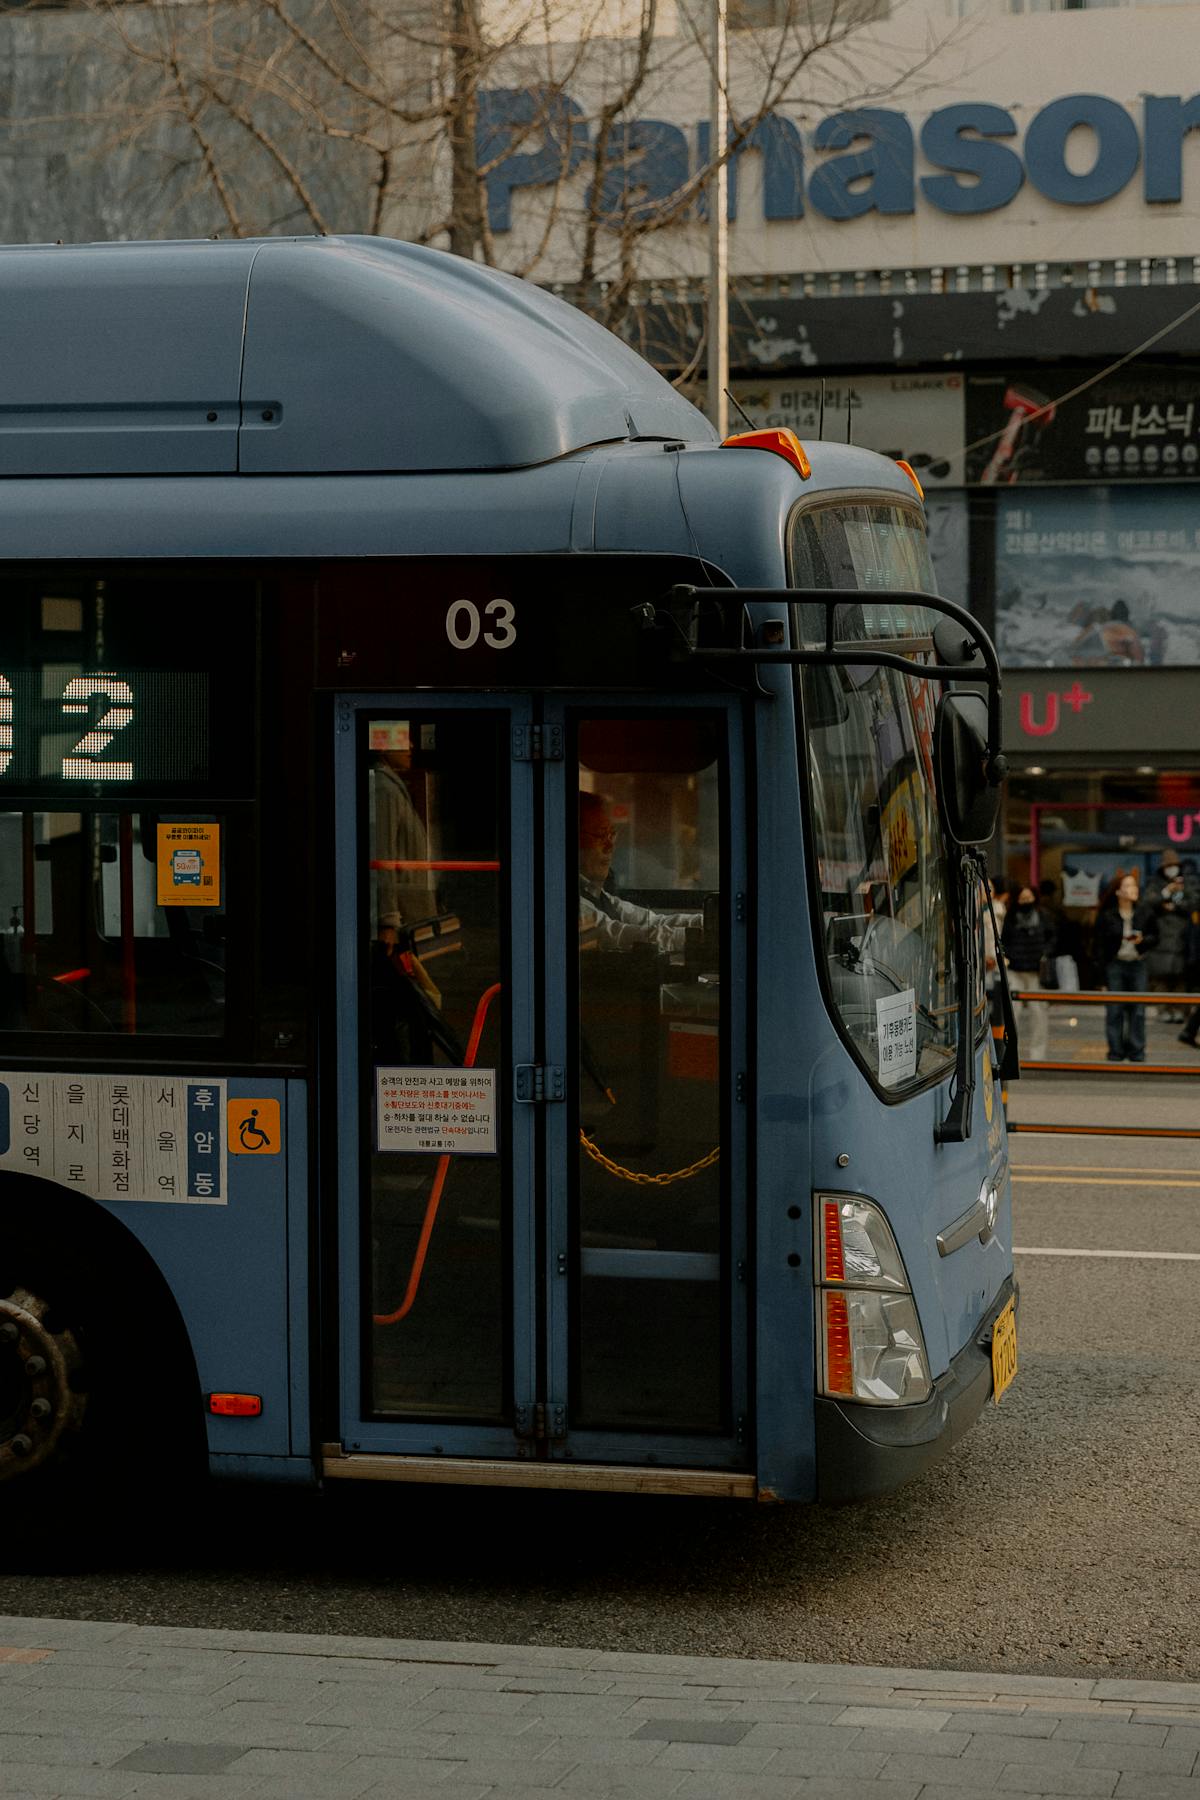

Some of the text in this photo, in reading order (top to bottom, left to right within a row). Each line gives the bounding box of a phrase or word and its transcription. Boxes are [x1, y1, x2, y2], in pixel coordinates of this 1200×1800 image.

[1085, 403, 1193, 440] 파나소닉
[445, 599, 518, 651] 03
[0, 672, 133, 780] 2
[1019, 681, 1093, 737] U+
[22, 1082, 41, 1167] 신당역
[381, 1077, 402, 1086] 승객의
[404, 1077, 427, 1086] 안전과
[429, 1077, 444, 1086] 사고
[66, 1083, 86, 1183] 을지로
[111, 1085, 131, 1193] 롯데백화점
[156, 1087, 176, 1196] 서울역
[193, 1088, 215, 1196] 후암동
